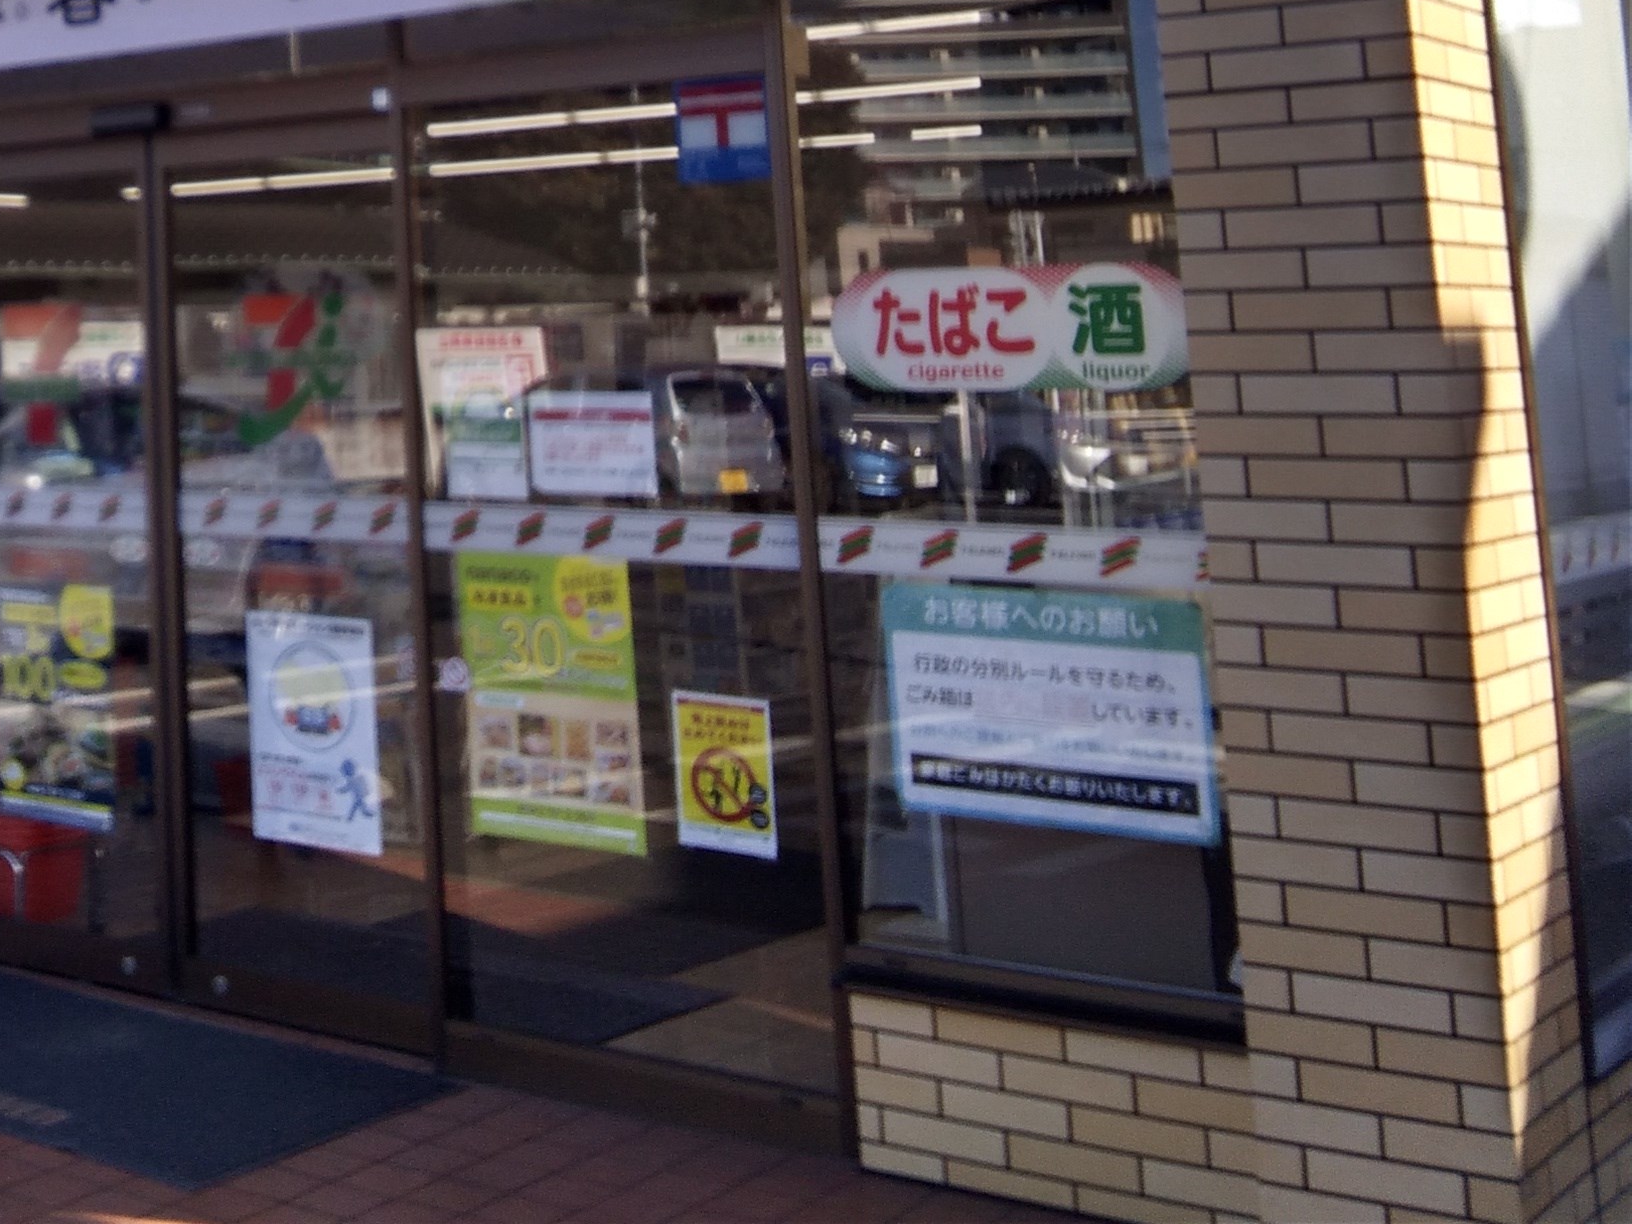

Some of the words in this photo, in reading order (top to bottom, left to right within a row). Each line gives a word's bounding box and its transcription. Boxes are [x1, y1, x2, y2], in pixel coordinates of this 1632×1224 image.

[872, 281, 1037, 358] たばこ
[1067, 282, 1147, 357] 酒
[907, 360, 1005, 383] cigarette
[1081, 360, 1151, 384] liquor
[923, 597, 1159, 639] お客様へのお願い
[919, 760, 1192, 809] ごみはかたくお断りいたします。
